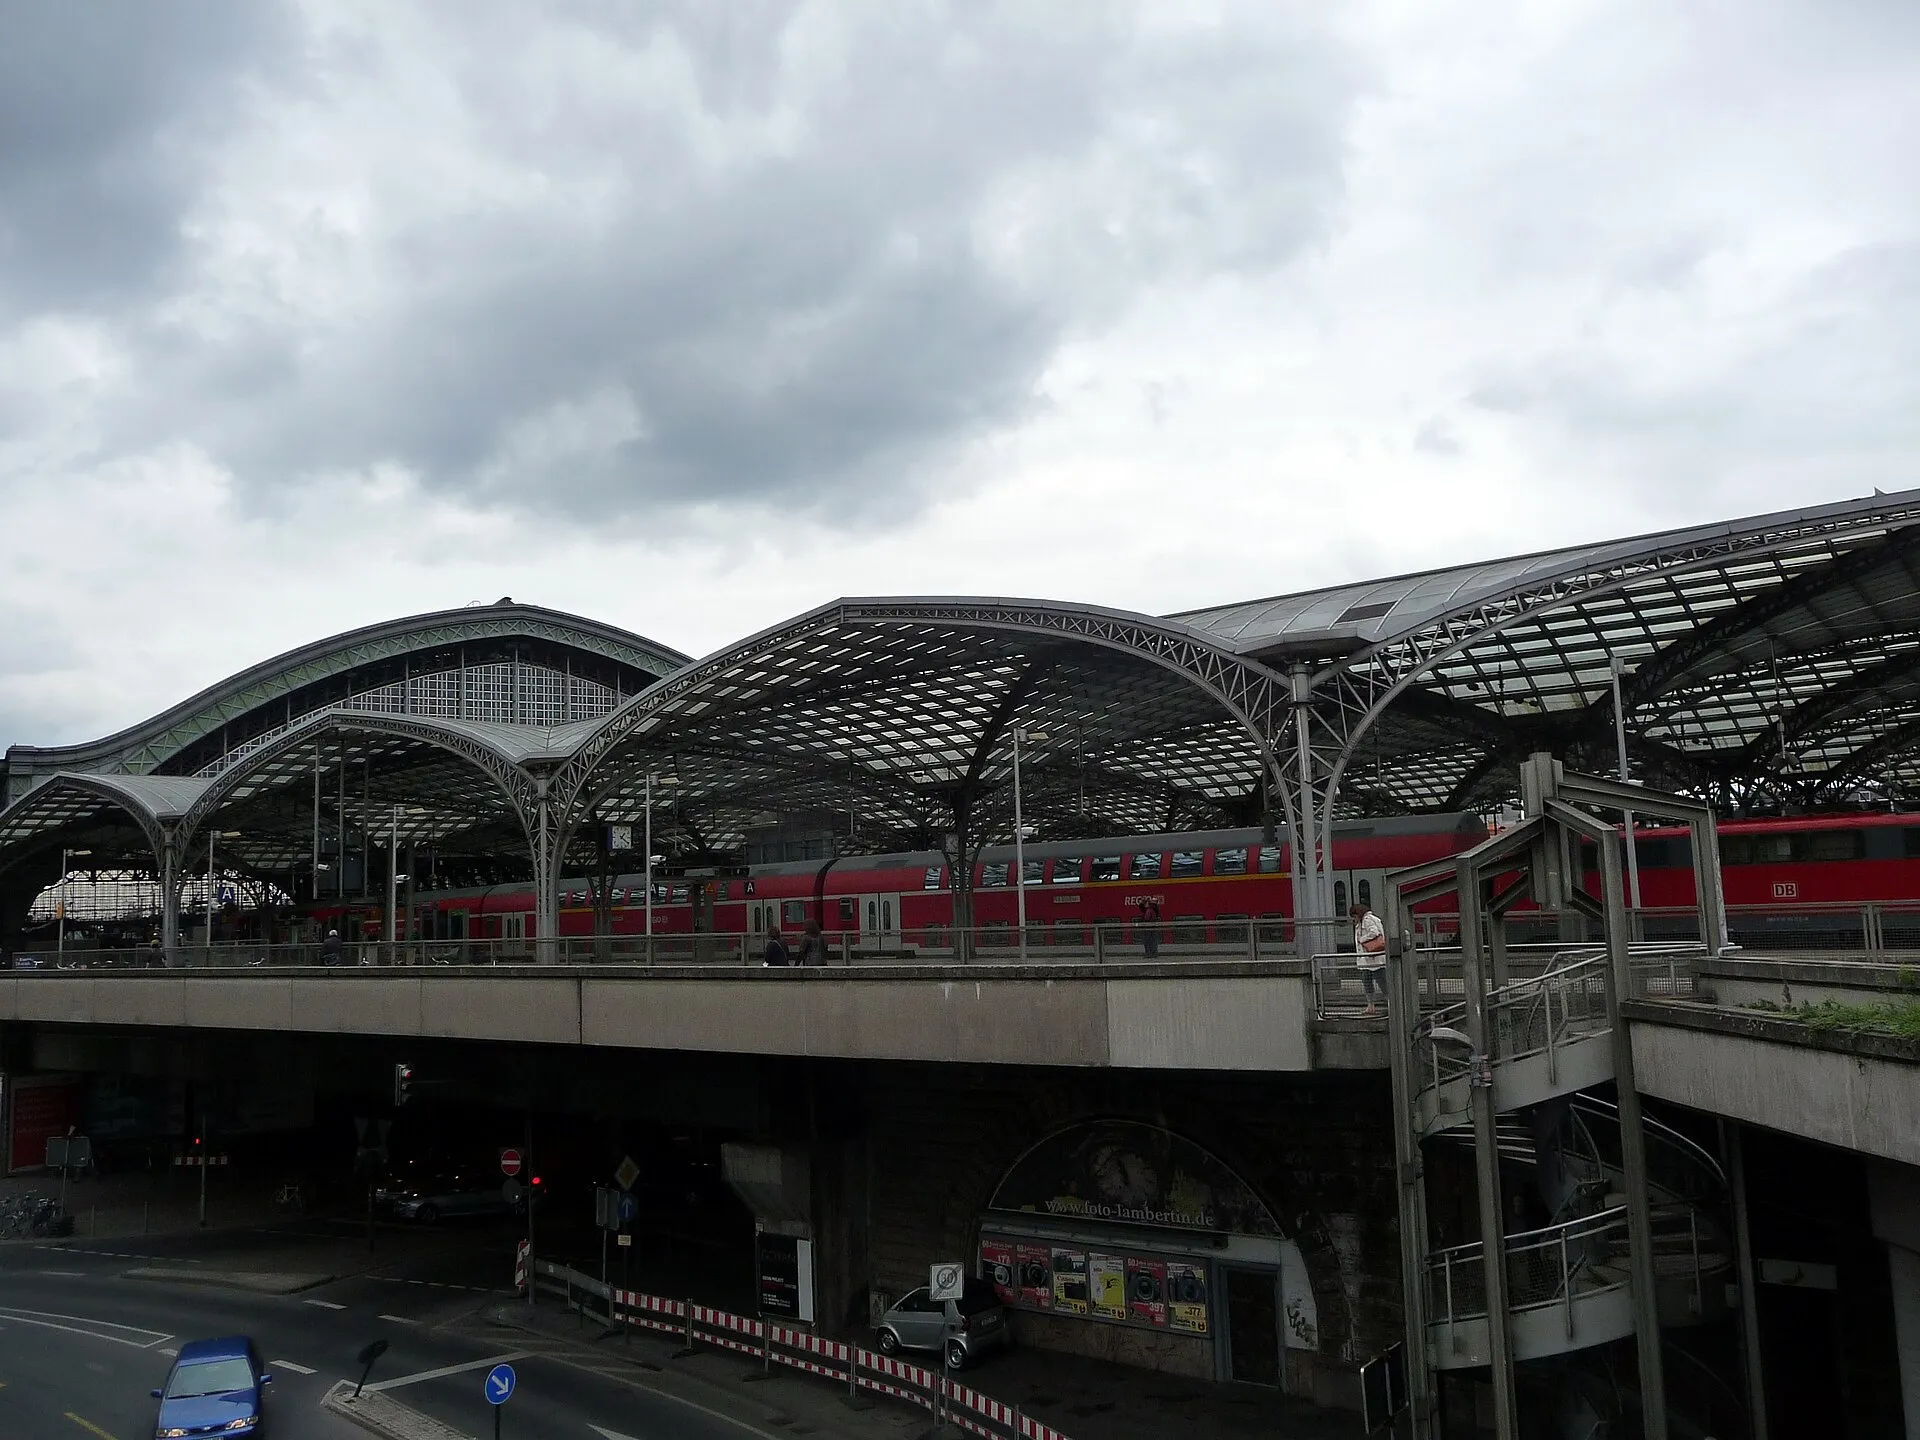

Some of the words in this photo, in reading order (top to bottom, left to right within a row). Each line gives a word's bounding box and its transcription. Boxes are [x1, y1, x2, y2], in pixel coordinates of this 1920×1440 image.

[747, 882, 754, 893] A
[1774, 883, 1797, 897] DB
[222, 888, 232, 899] A
[1045, 1200, 1214, 1226] www.foto-lambertin.de
[1149, 1302, 1164, 1312] 397
[1188, 1306, 1201, 1316] 377
